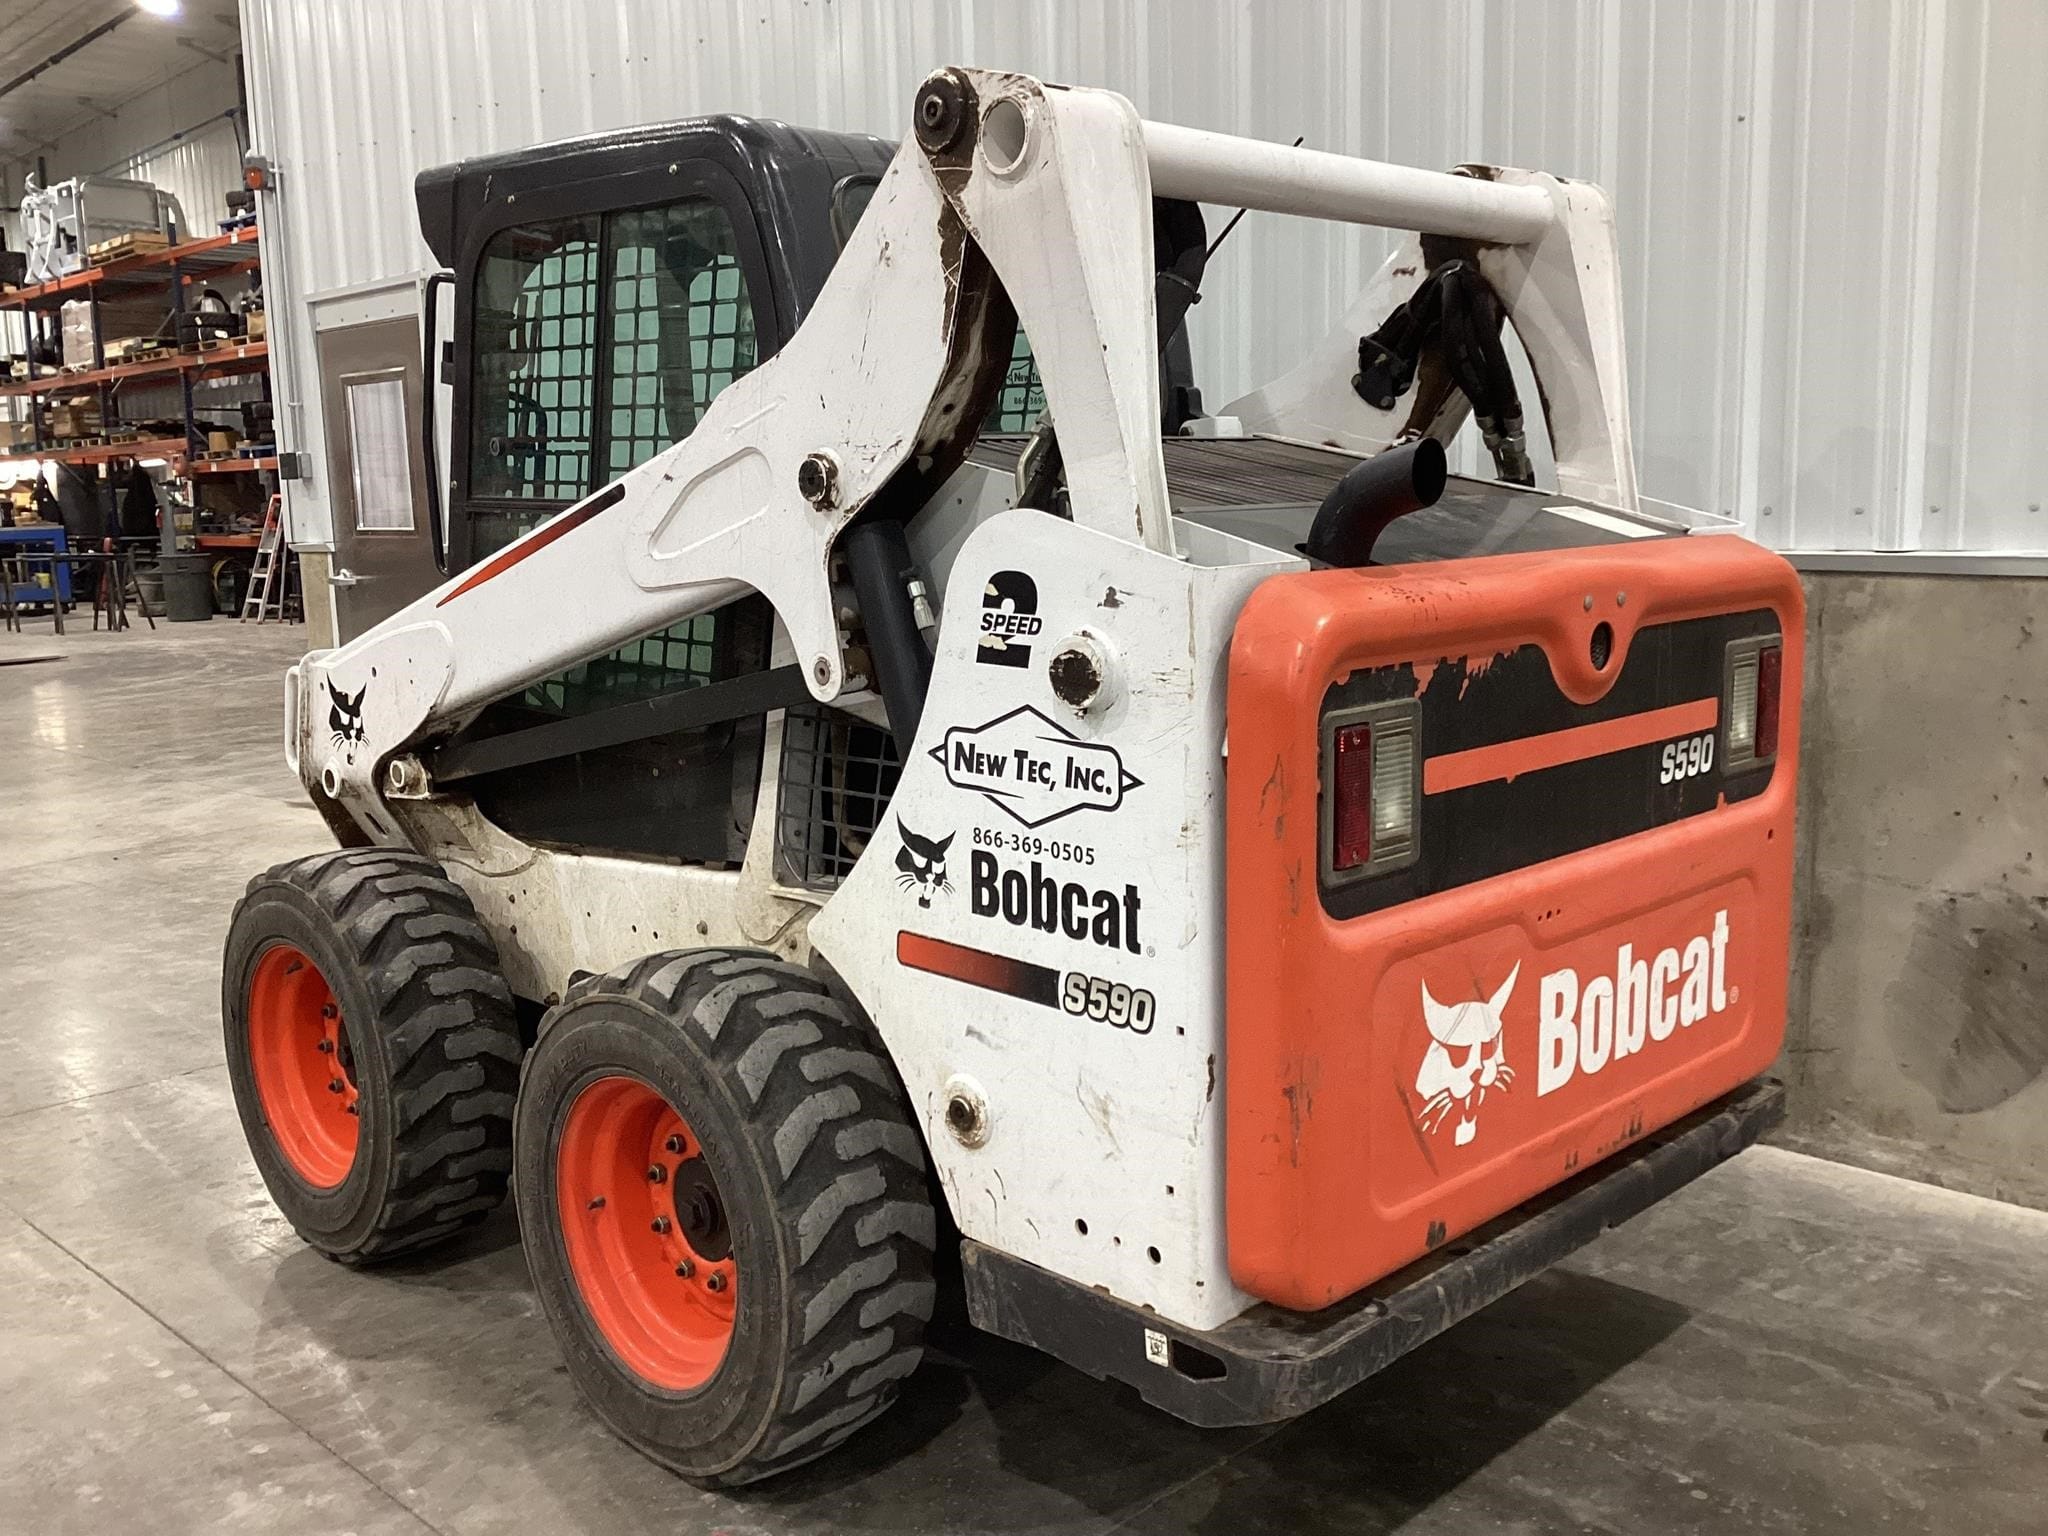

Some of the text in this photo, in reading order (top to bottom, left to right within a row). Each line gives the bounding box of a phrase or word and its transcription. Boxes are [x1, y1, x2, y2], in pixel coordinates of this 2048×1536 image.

[980, 612, 1043, 636] SPEED
[1659, 733, 1715, 785] S590
[973, 827, 1095, 866] 866-369-0505
[971, 848, 1141, 955] Bobcat
[1062, 971, 1156, 1035] S590
[1537, 909, 1729, 1098] Bobcat
